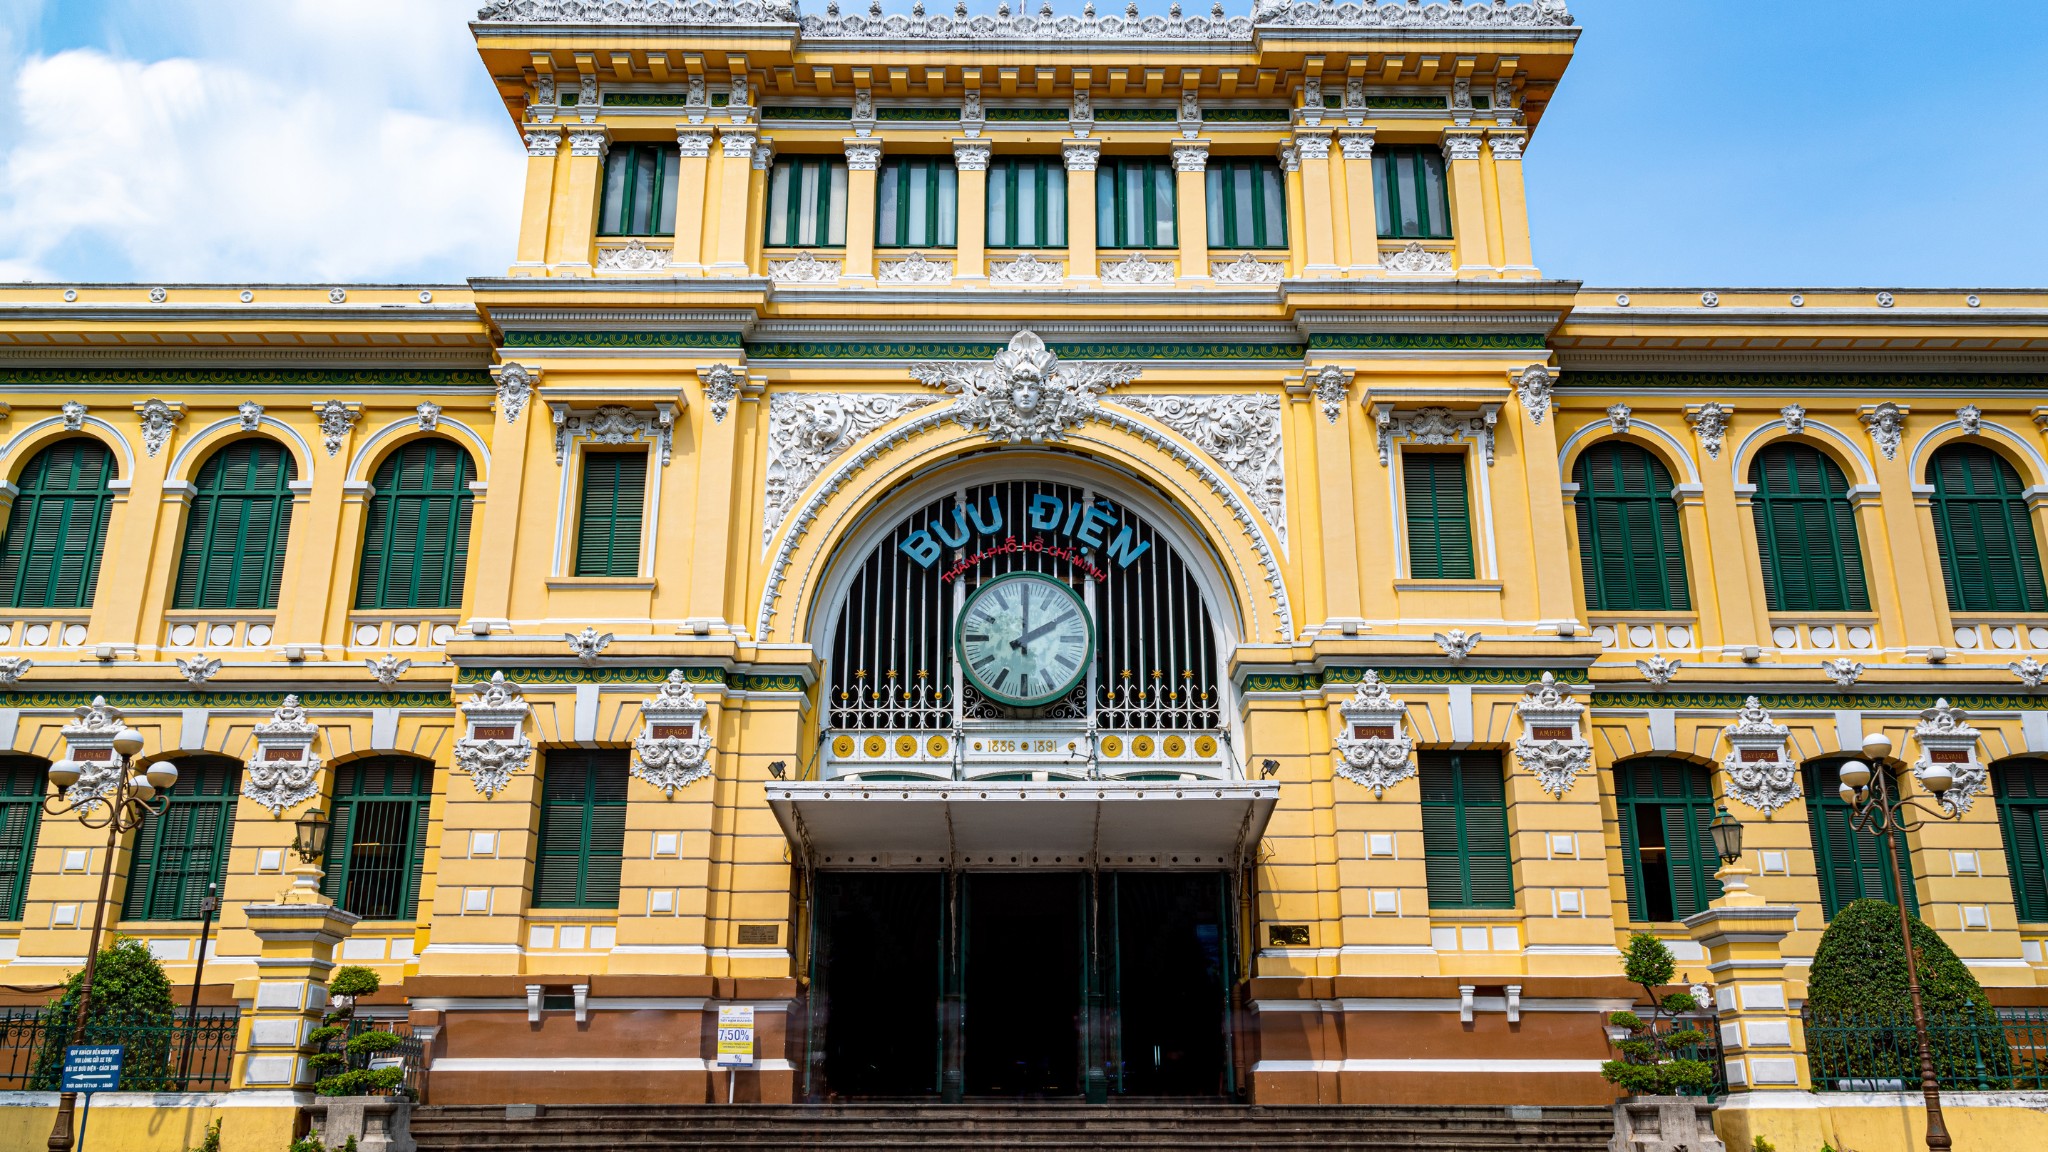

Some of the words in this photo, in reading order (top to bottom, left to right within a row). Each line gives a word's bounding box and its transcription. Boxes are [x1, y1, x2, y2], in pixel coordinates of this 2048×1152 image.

[899, 496, 1003, 570] BƯU
[1029, 493, 1151, 571] ĐIỆN
[941, 551, 985, 583] THÀNH
[987, 535, 1017, 558] PHỐ
[1021, 535, 1044, 552] HỒ
[1048, 546, 1076, 561] CHÍ
[1072, 555, 1107, 582] MINH
[665, 728, 688, 736] ARAGO
[988, 740, 1015, 752] 1886
[1034, 740, 1057, 752] 1891
[719, 1029, 749, 1041] 7,50%
